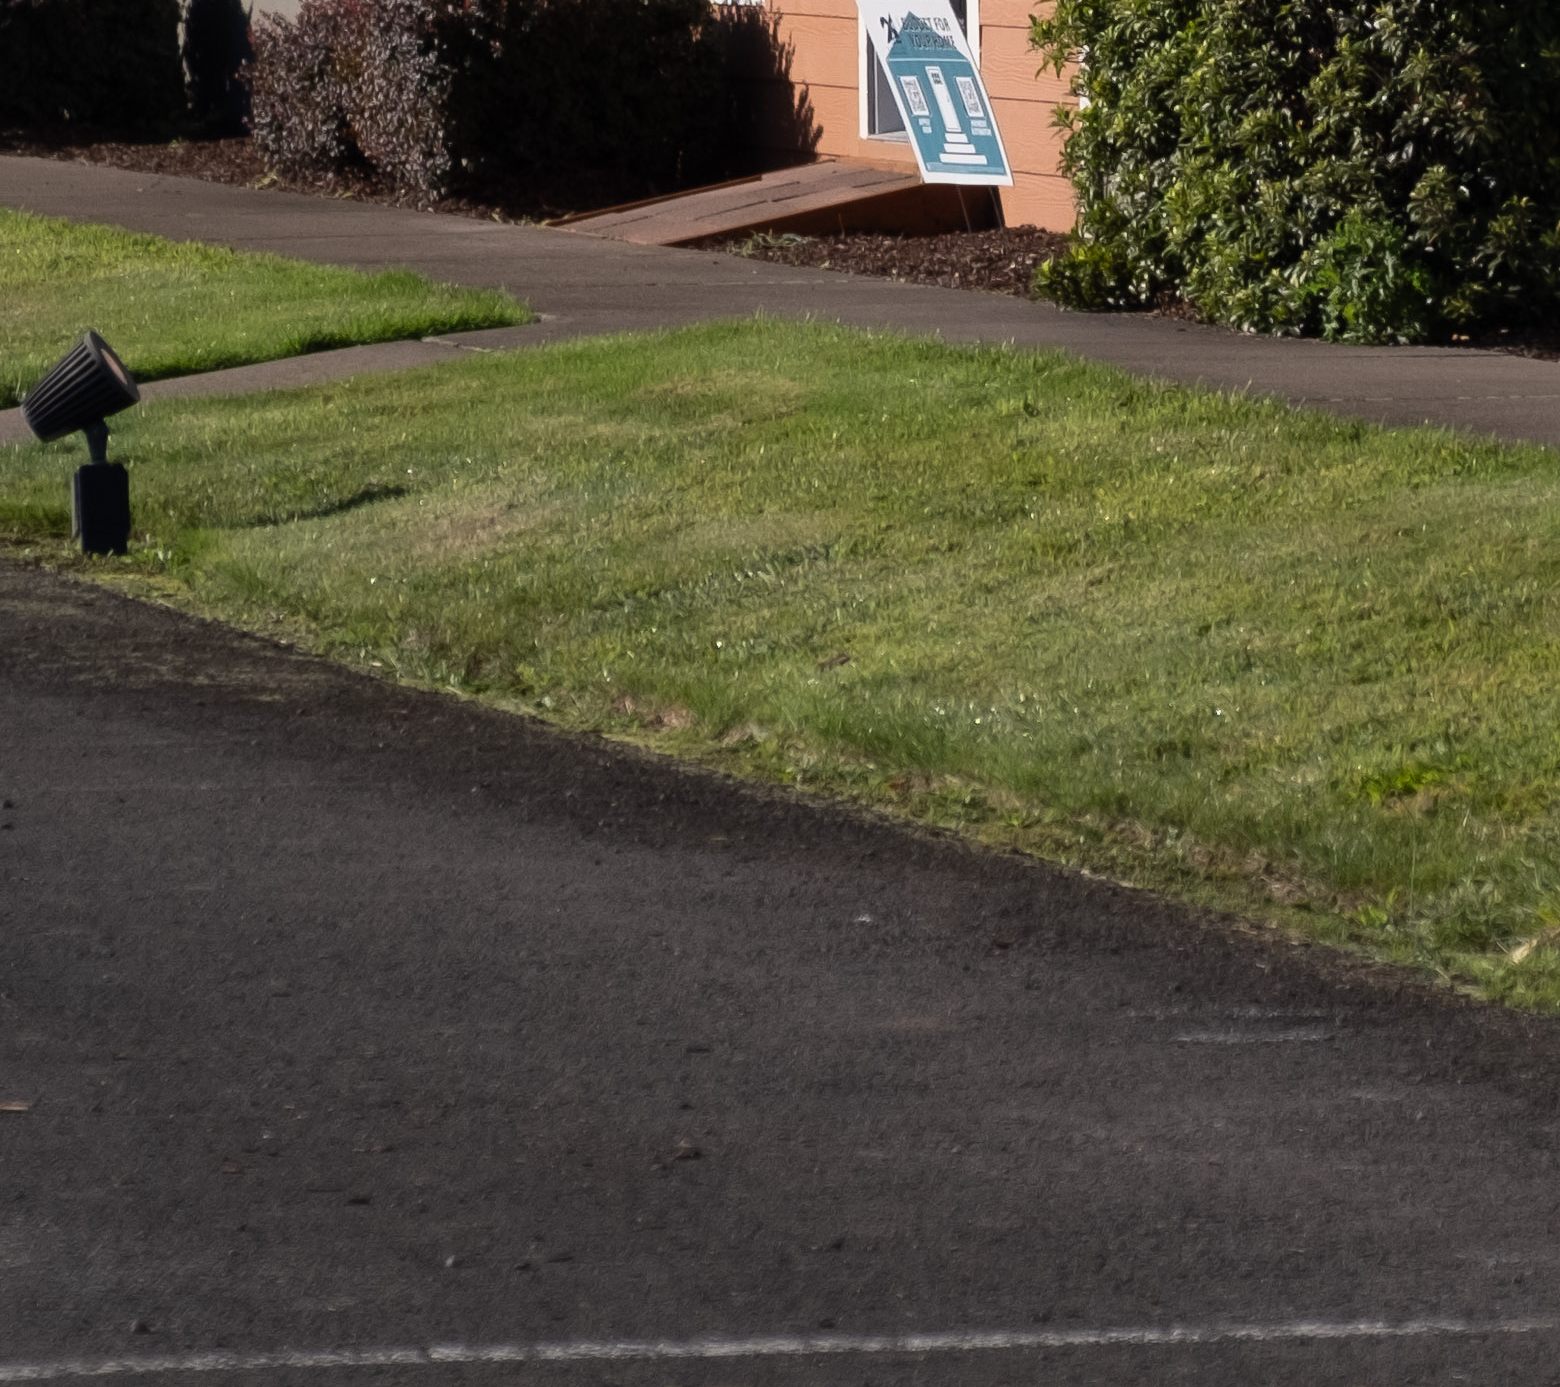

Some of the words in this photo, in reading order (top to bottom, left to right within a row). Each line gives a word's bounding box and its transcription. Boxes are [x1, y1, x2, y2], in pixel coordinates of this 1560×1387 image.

[901, 16, 934, 31] BUDGET
[934, 17, 951, 32] FOR
[911, 34, 934, 48] YOUR
[934, 35, 955, 48] HOME
